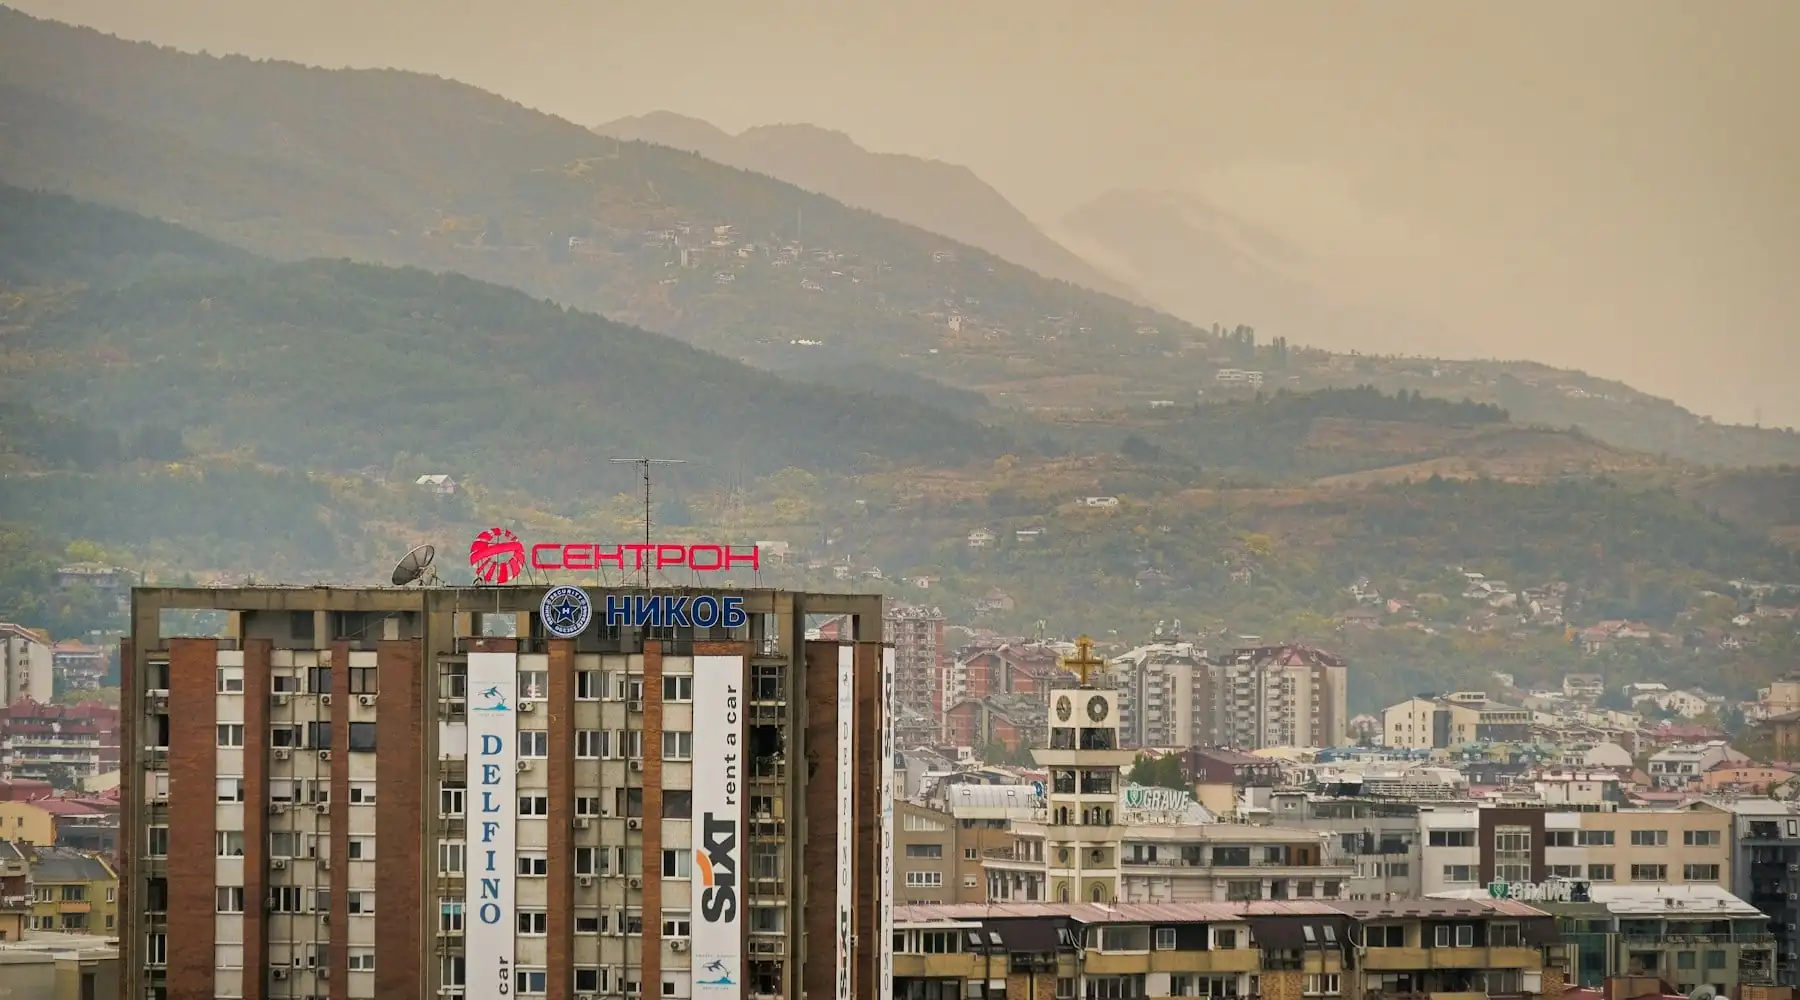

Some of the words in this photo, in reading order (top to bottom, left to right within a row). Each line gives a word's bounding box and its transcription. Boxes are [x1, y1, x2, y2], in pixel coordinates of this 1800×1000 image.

[531, 544, 759, 571] СЕНТРОН
[549, 589, 582, 600] SECURITY
[606, 594, 748, 628] НИКОБ
[726, 684, 737, 724] car
[726, 733, 737, 746] a
[724, 753, 736, 806] rent
[1143, 789, 1190, 811] GRAWE
[480, 734, 503, 924] DELFINO
[498, 956, 509, 995] car
